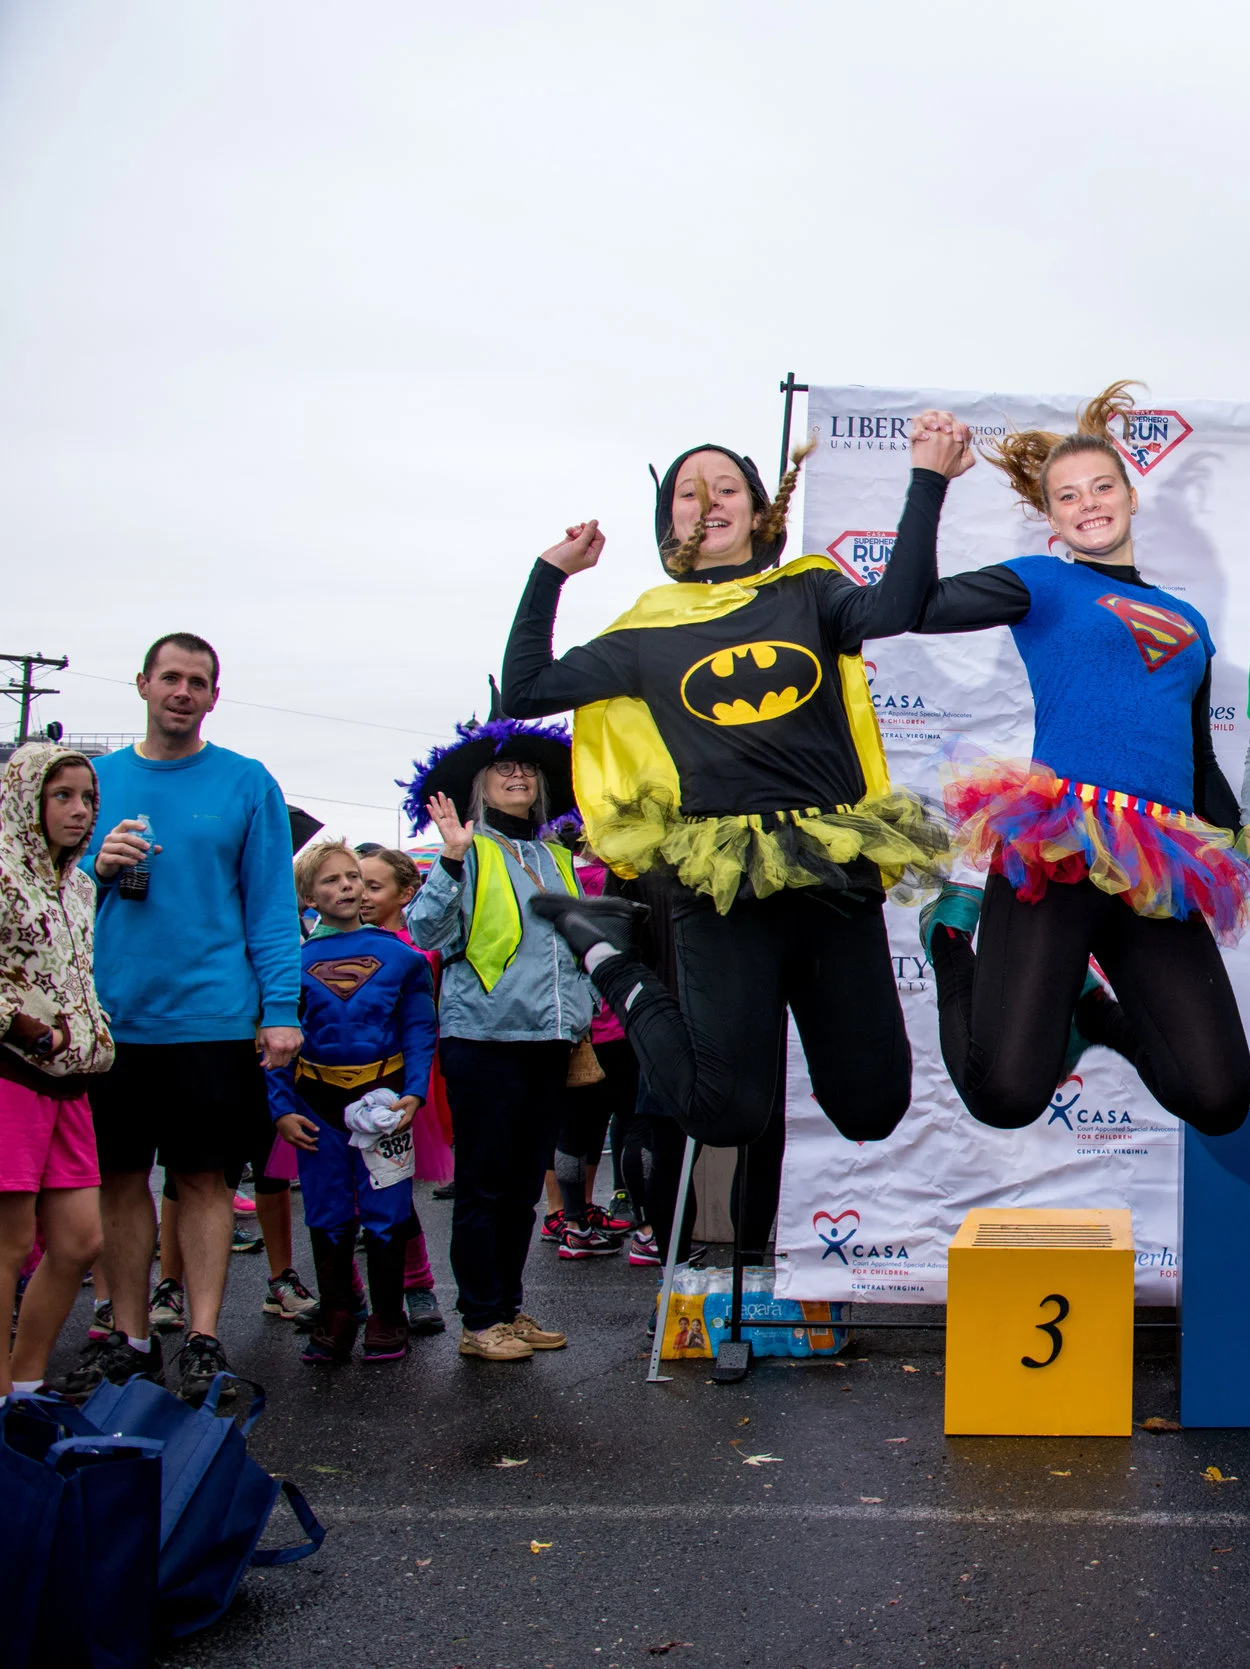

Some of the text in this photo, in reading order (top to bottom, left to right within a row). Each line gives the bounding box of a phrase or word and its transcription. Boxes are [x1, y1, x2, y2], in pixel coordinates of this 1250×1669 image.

[1127, 415, 1169, 424] UPERHERO
[830, 416, 909, 439] LIBER
[967, 425, 1006, 436] CHOOL
[1122, 422, 1169, 441] RUN
[830, 440, 907, 451] UNIVERS
[853, 537, 895, 545] SUPERHER
[872, 694, 926, 709] CASA
[942, 711, 973, 719] Advocates
[1077, 1109, 1133, 1124] CASA
[380, 1132, 413, 1159] 382
[852, 1244, 909, 1259] CASA
[851, 1283, 925, 1292] CENTRAL VIRGINIA
[725, 1303, 783, 1320] nagara
[1020, 1294, 1070, 1369] 3
